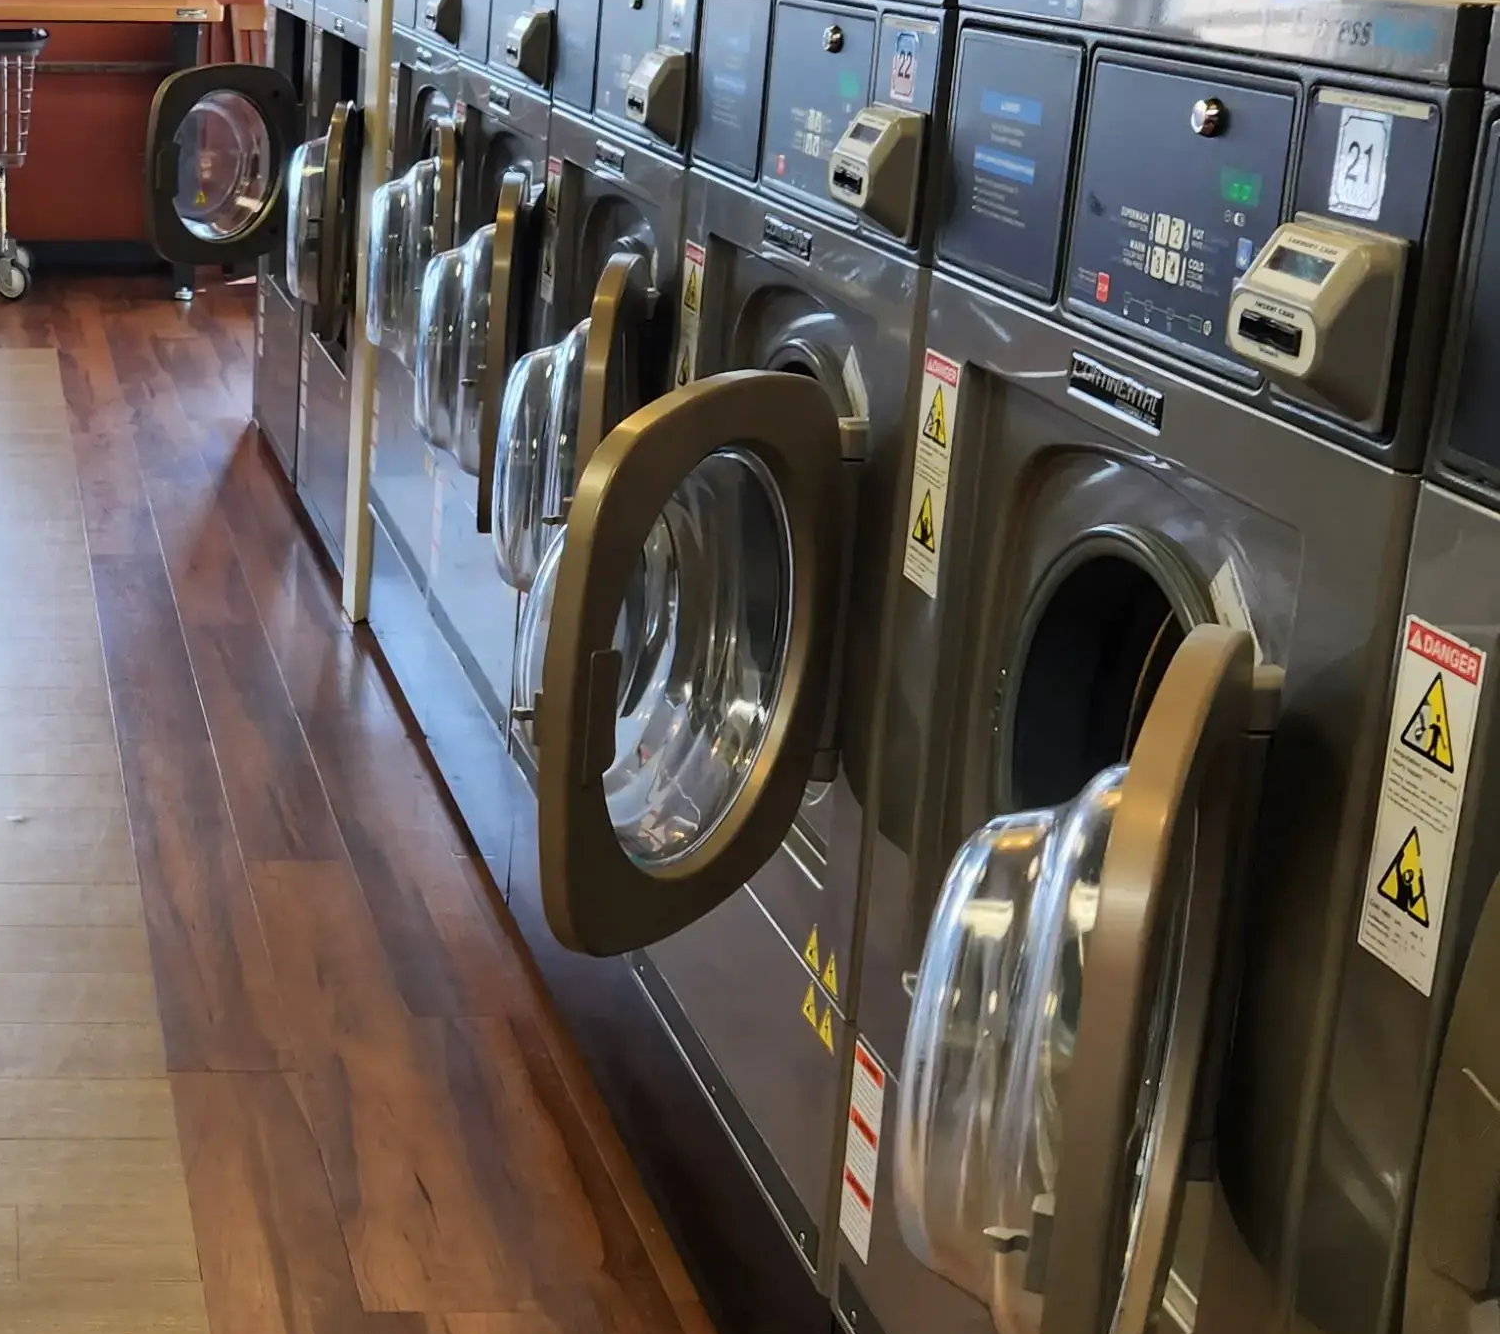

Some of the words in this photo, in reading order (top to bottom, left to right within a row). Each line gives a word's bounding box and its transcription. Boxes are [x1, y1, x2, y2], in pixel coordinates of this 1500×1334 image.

[897, 49, 913, 80] 22
[1344, 140, 1374, 184] 21
[1422, 635, 1478, 679] DANGER
